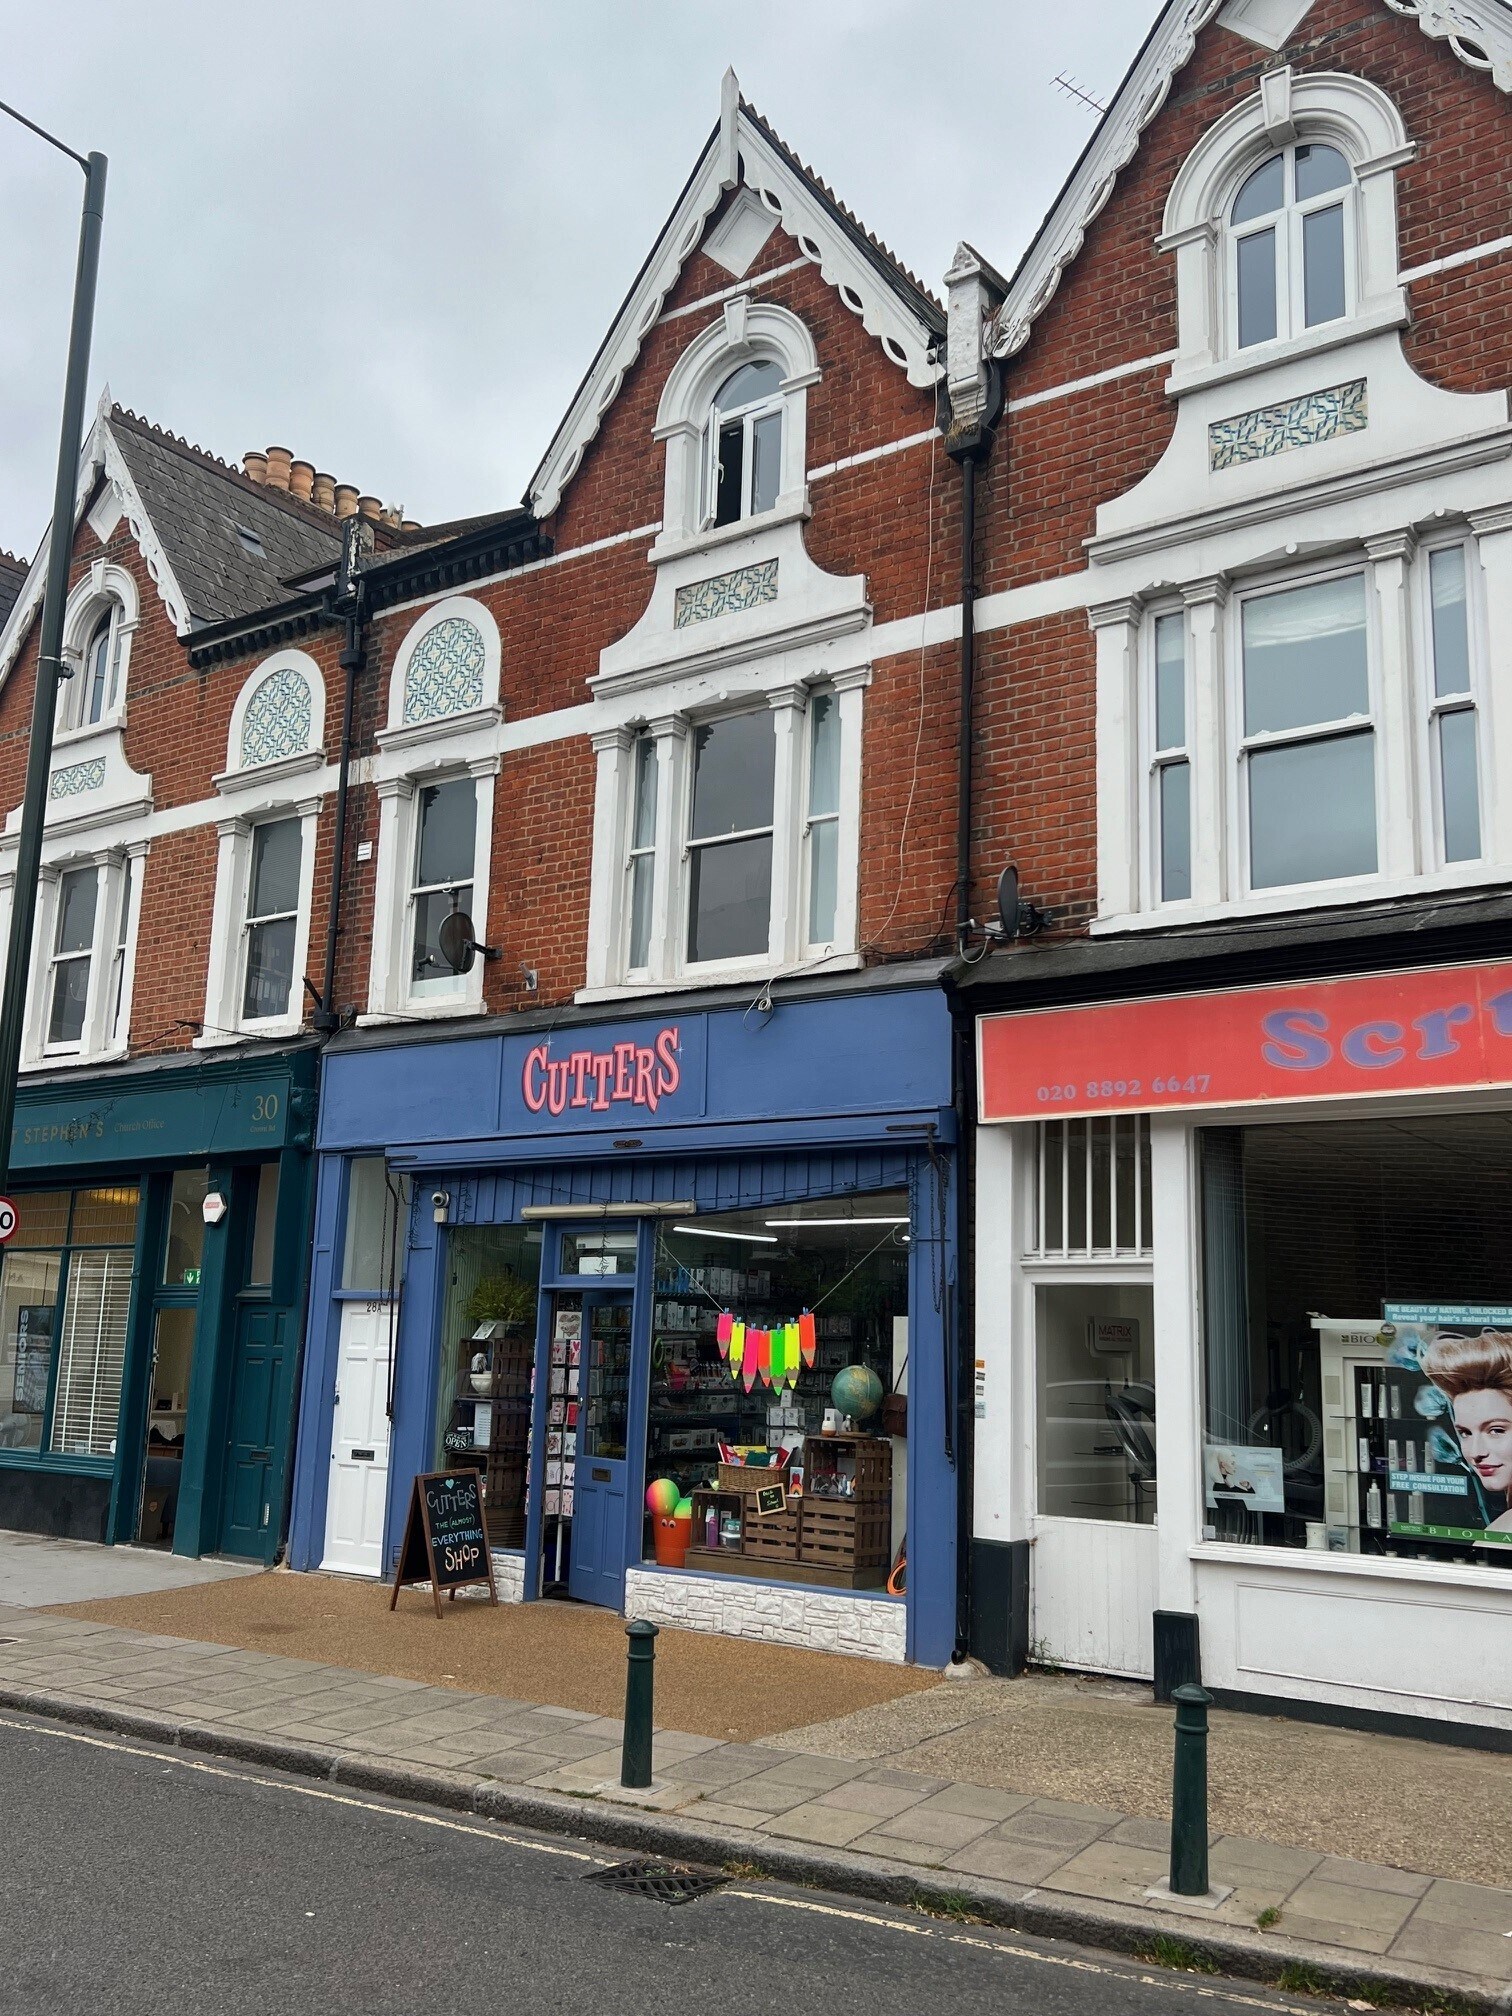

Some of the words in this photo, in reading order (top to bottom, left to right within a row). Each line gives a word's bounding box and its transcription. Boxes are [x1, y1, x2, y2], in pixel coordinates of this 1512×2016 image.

[522, 1024, 681, 1117] CUTTERS
[1036, 1084, 1077, 1102] 020
[1086, 1080, 1141, 1098] 8892
[1151, 1075, 1211, 1094] 6647
[252, 1094, 278, 1120] 30
[142, 1118, 165, 1129] Office
[1386, 1305, 1400, 1313] THE
[1402, 1305, 1428, 1314] BEAUTY
[1429, 1306, 1439, 1314] OF
[1470, 1307, 1507, 1315] UNLOCKED
[1392, 1313, 1418, 1321] Reveal
[1438, 1314, 1460, 1322] hair's
[1462, 1315, 1490, 1323] natural
[1099, 1325, 1132, 1337] MATRIX
[15, 1310, 29, 1401] SENIORS
[446, 1436, 468, 1448] OPEN
[1409, 1474, 1431, 1482] INSIDE
[1446, 1477, 1465, 1485] YOUR
[1412, 1482, 1466, 1493] CONSULTATION
[427, 1484, 477, 1514] CUTTERS
[435, 1522, 449, 1530] THE
[449, 1513, 476, 1530] (ALMOST)
[431, 1528, 483, 1547] EVERYTHING
[445, 1544, 480, 1572] SHOP
